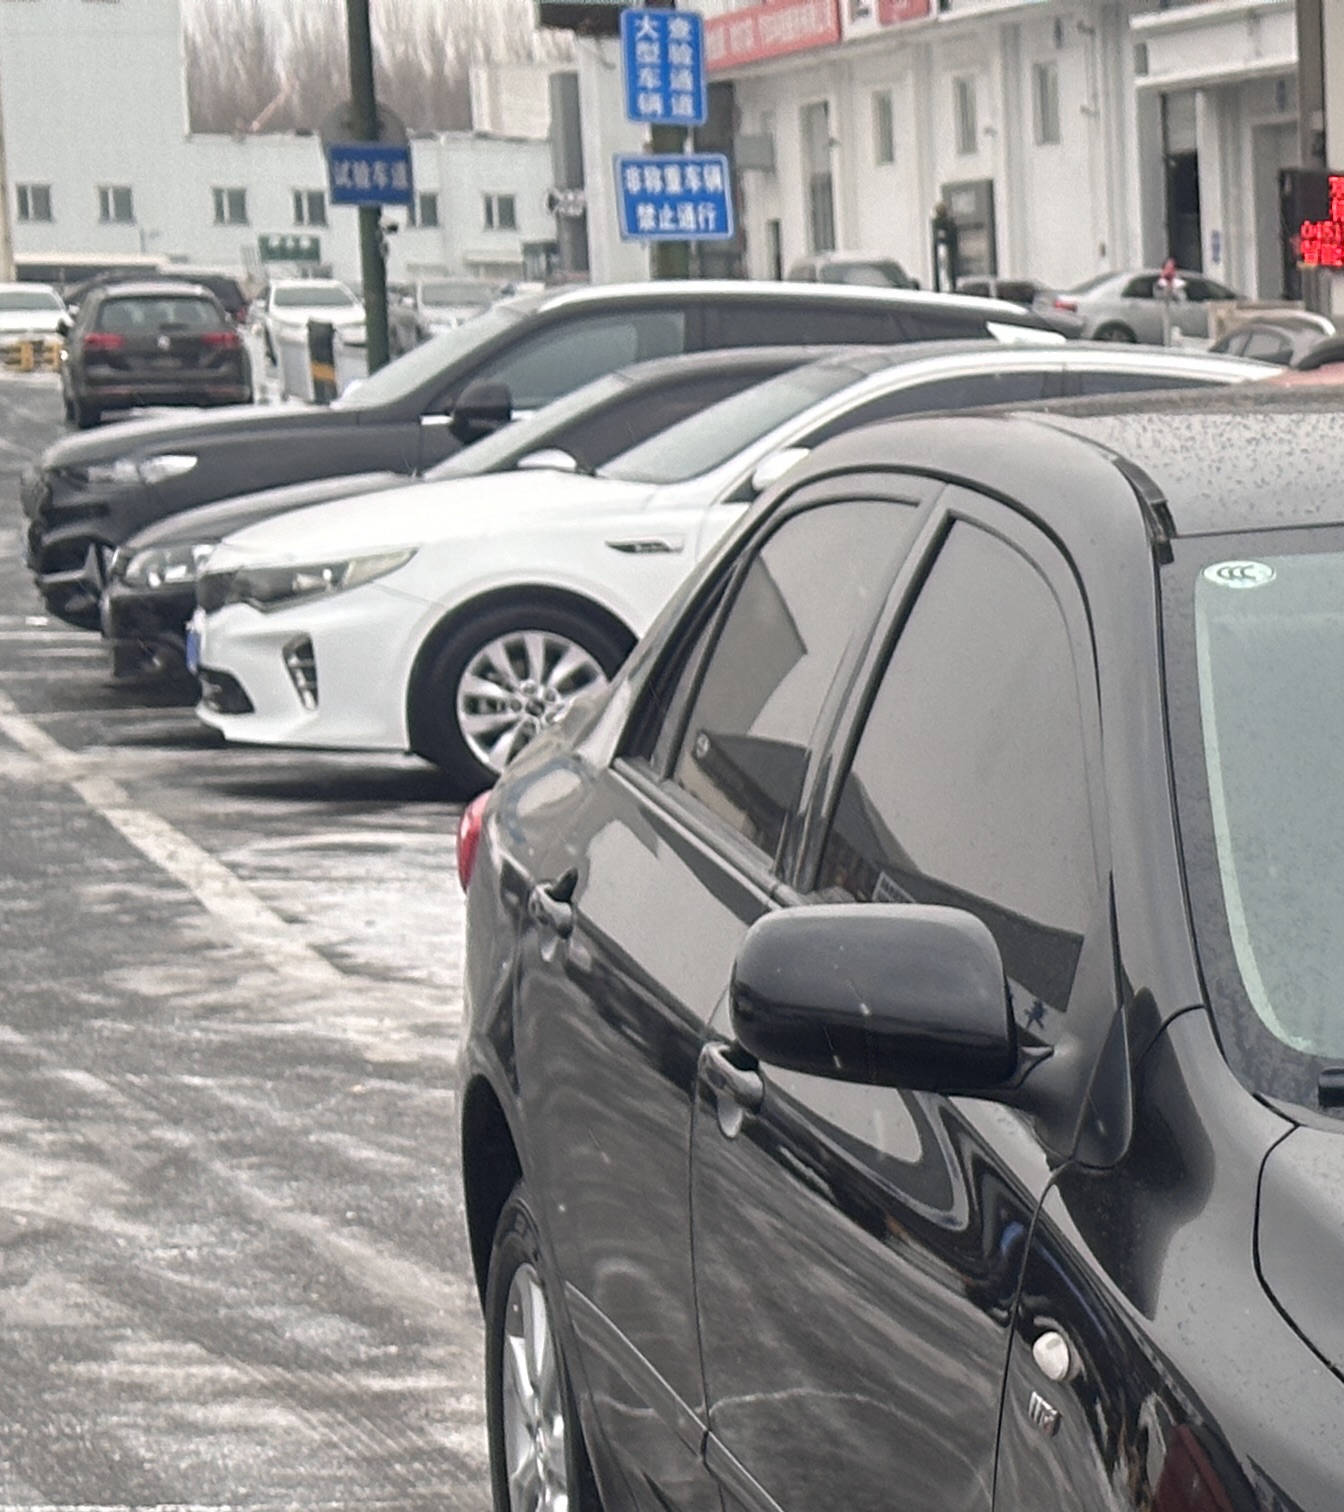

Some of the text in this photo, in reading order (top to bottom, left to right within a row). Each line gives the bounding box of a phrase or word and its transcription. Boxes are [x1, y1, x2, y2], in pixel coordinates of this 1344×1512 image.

[634, 14, 664, 117] 大型车辆
[636, 202, 717, 232] 禁止通行
